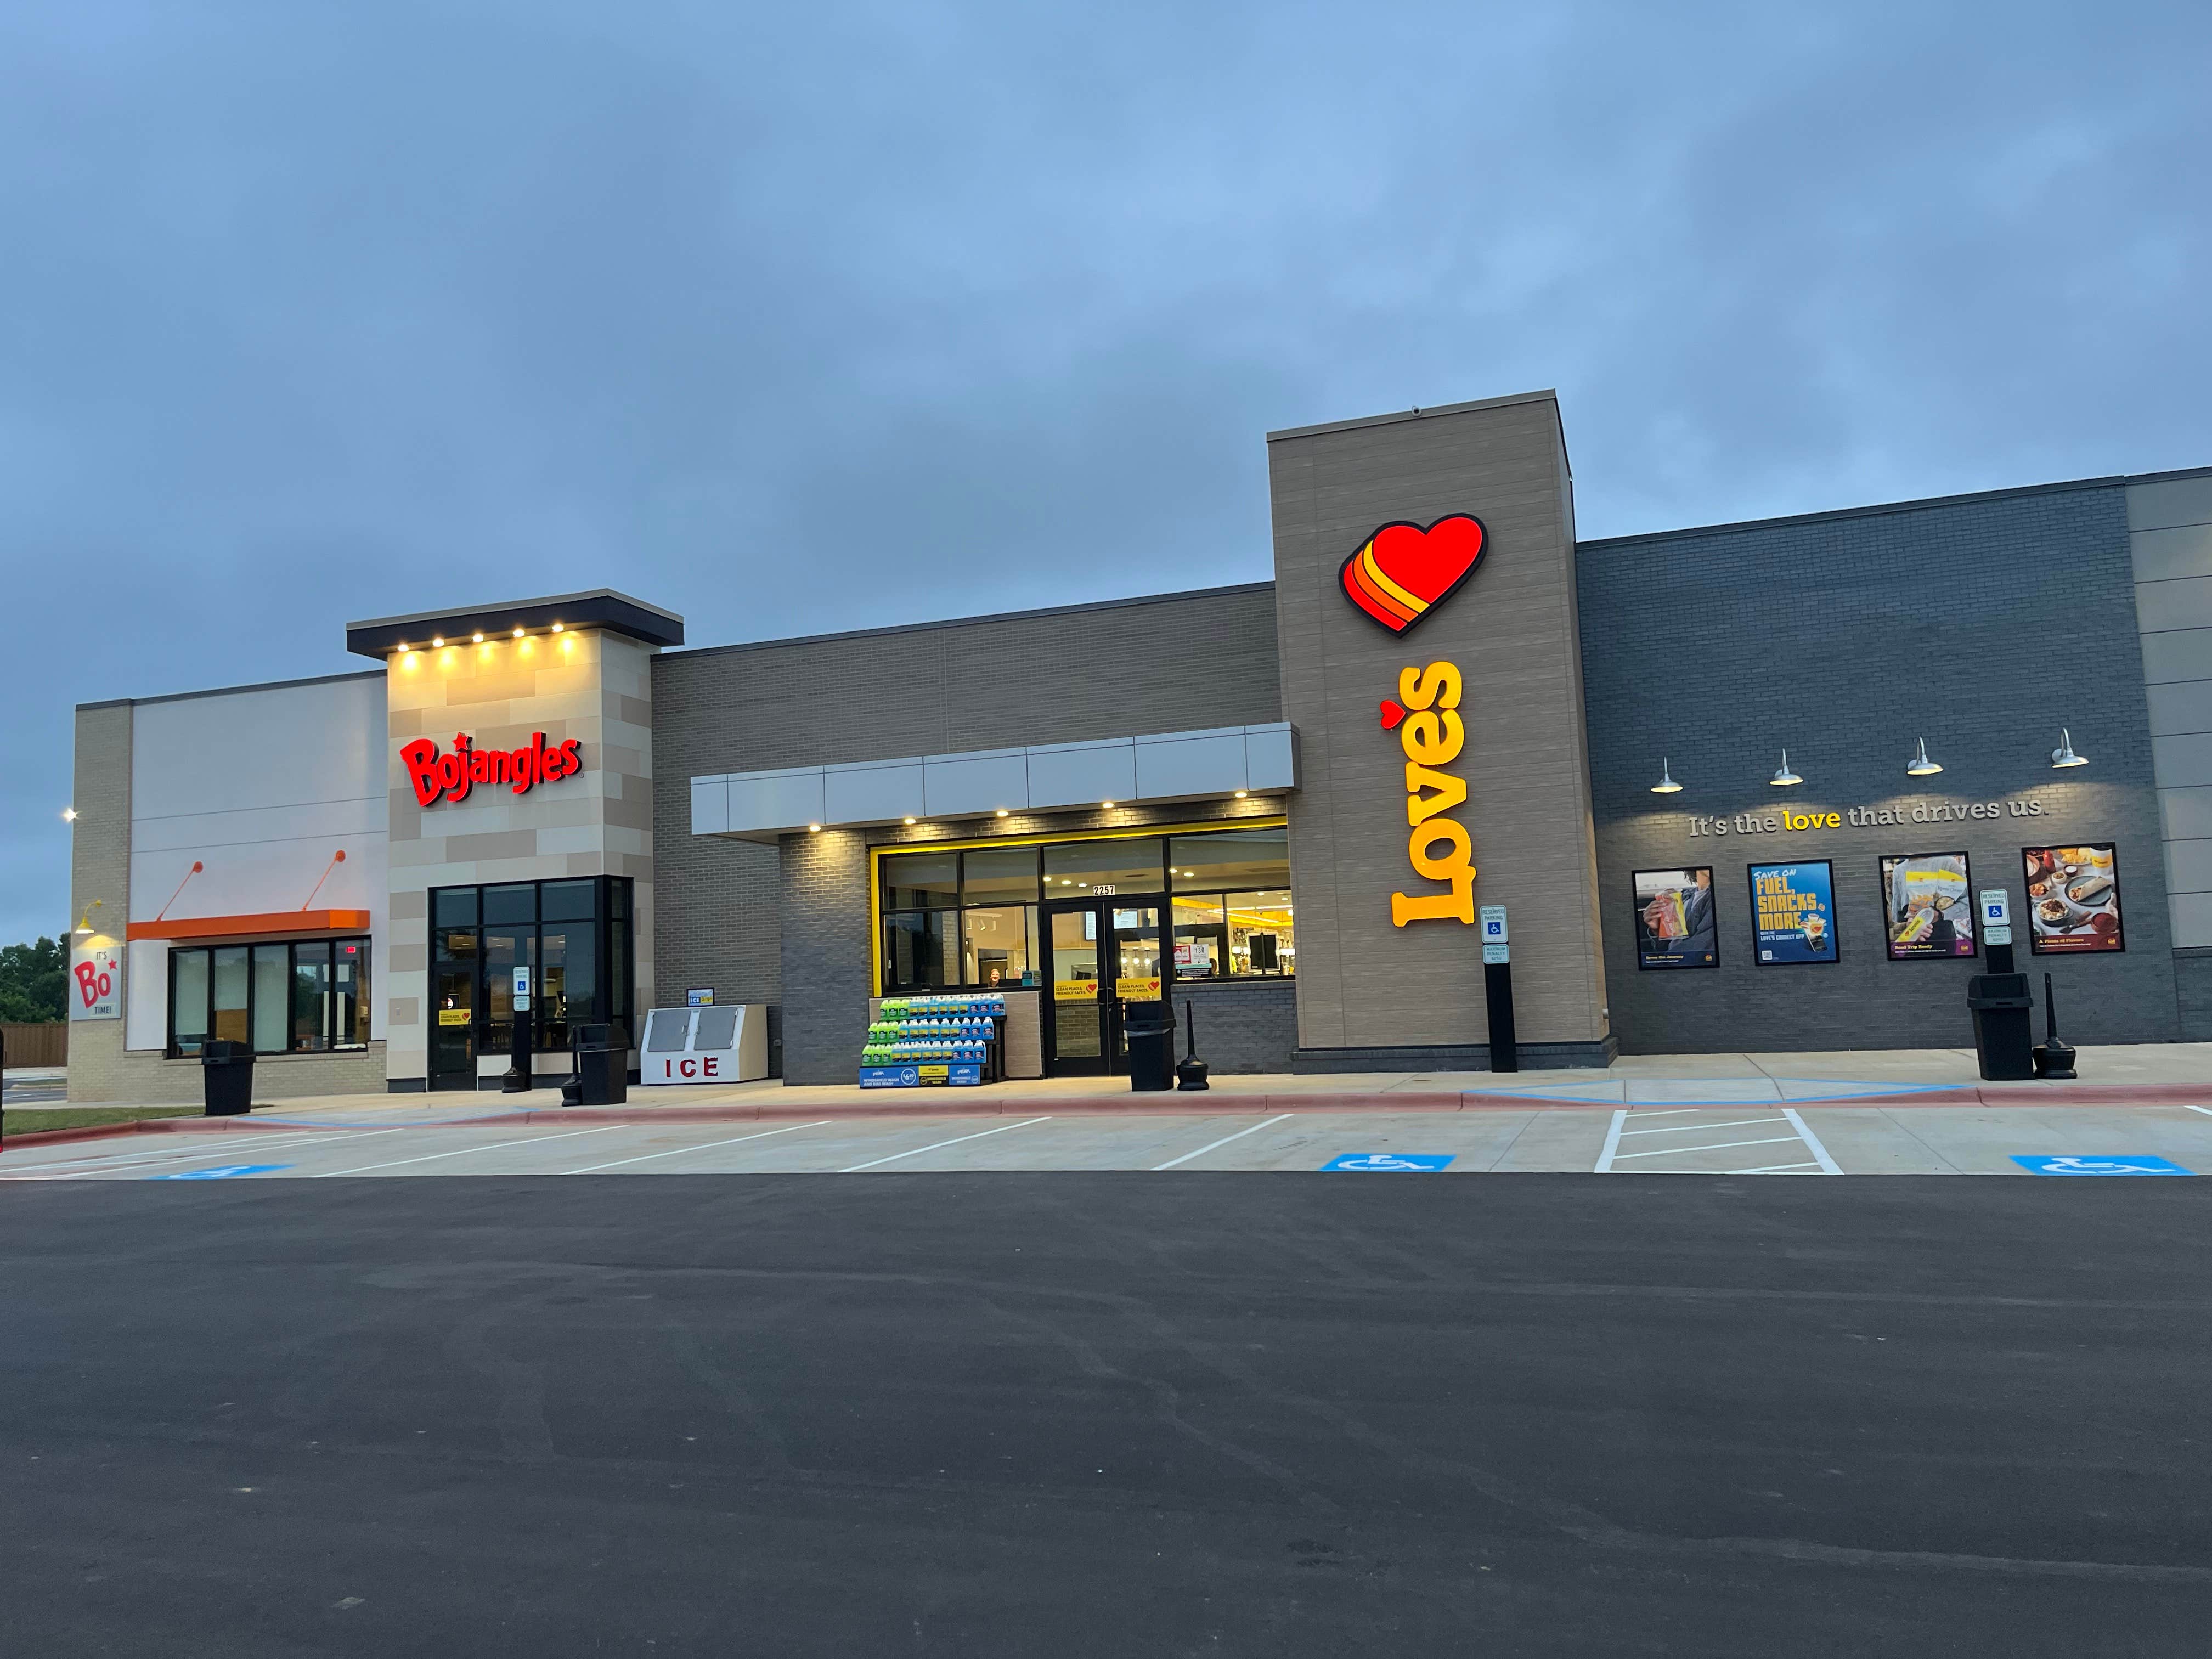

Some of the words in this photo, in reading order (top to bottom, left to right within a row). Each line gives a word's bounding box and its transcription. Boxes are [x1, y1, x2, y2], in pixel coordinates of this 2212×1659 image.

[400, 732, 582, 807] Bojangles
[1689, 815, 1728, 837] It's
[1734, 814, 1777, 834] the
[1782, 810, 1841, 831] love
[1848, 805, 1905, 827] that
[1911, 800, 2000, 823] drives
[1753, 870, 1779, 881] SAVE
[1094, 886, 1114, 895] 2257
[1756, 877, 1795, 895] FUEL,
[1759, 912, 1803, 930] MORE
[96, 951, 107, 960] IT'S
[74, 961, 111, 1008] Bo
[666, 1057, 718, 1077] ICE
